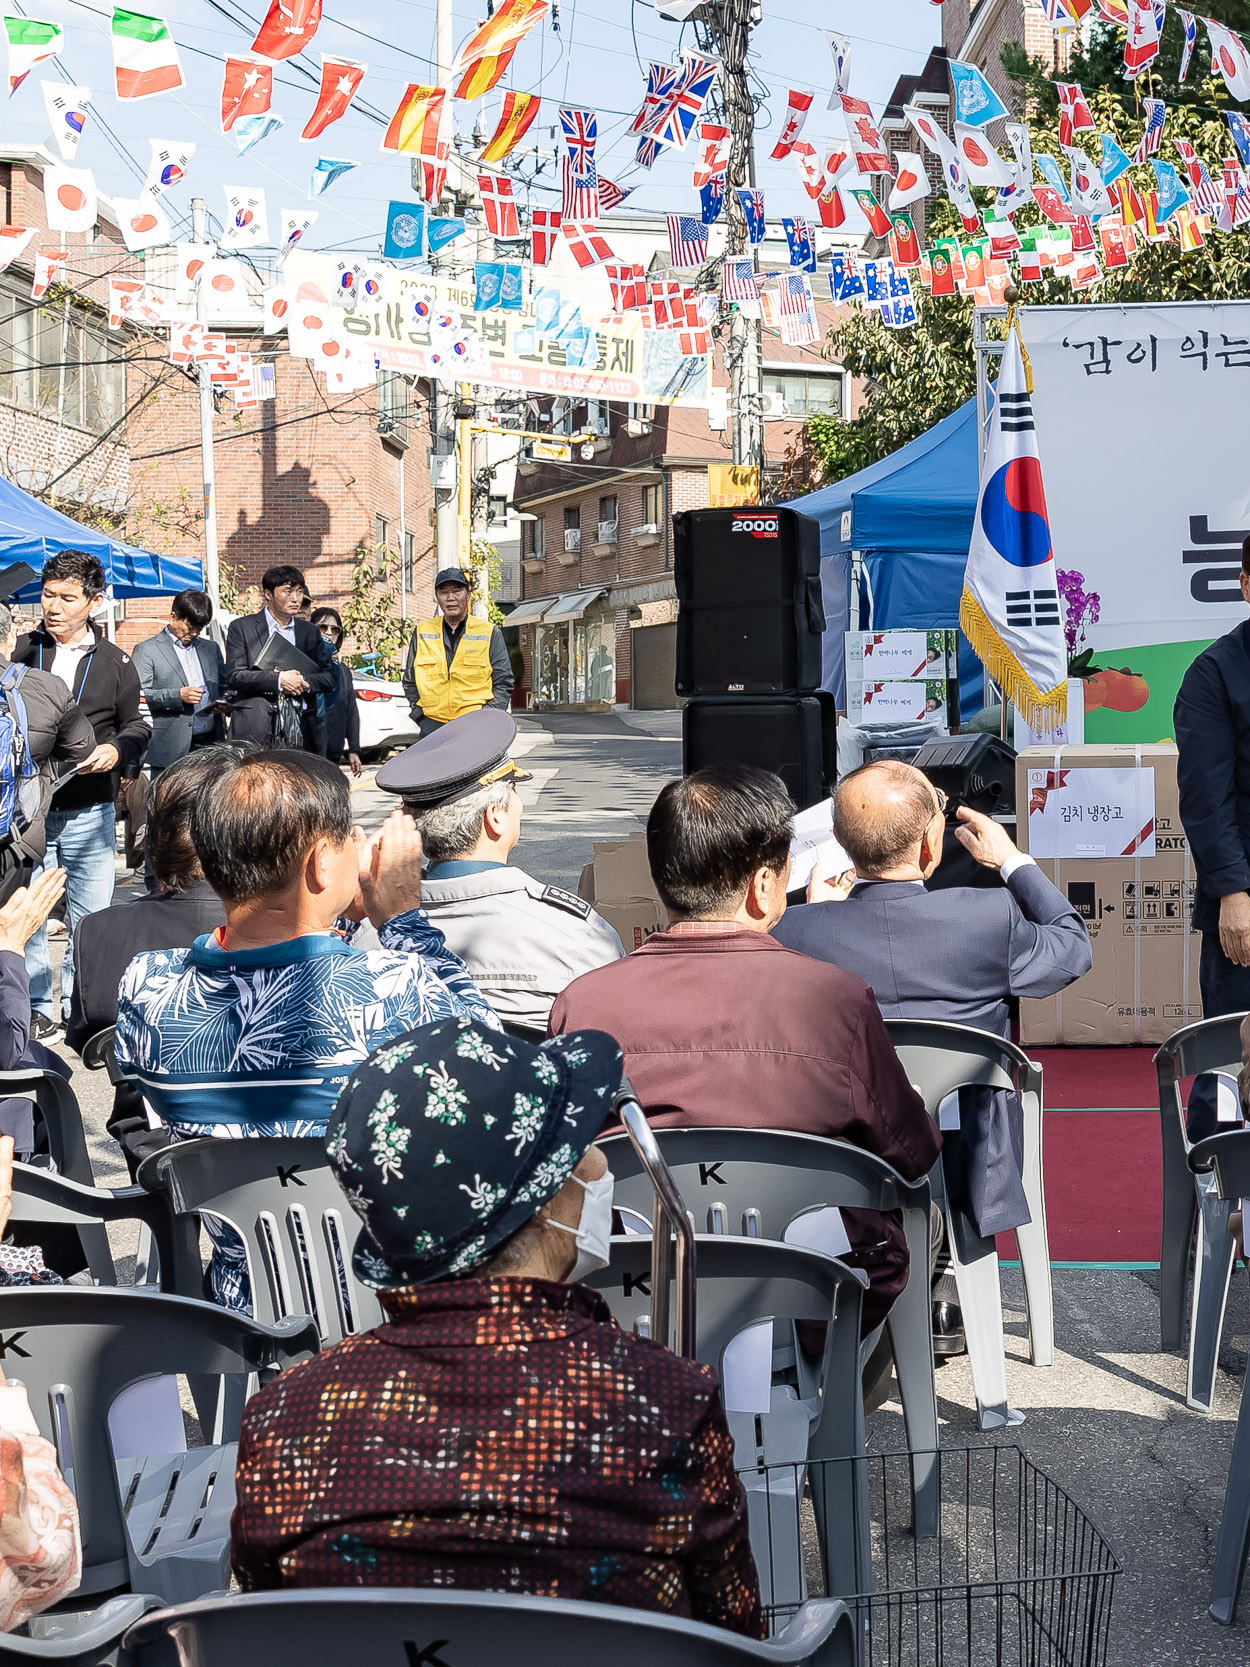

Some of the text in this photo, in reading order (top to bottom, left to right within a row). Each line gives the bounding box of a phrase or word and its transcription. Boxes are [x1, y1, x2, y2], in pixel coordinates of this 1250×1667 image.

[1060, 805, 1124, 822] 김치 냉장고
[276, 1163, 305, 1187] K
[699, 1162, 727, 1186] K
[623, 1271, 652, 1298] K
